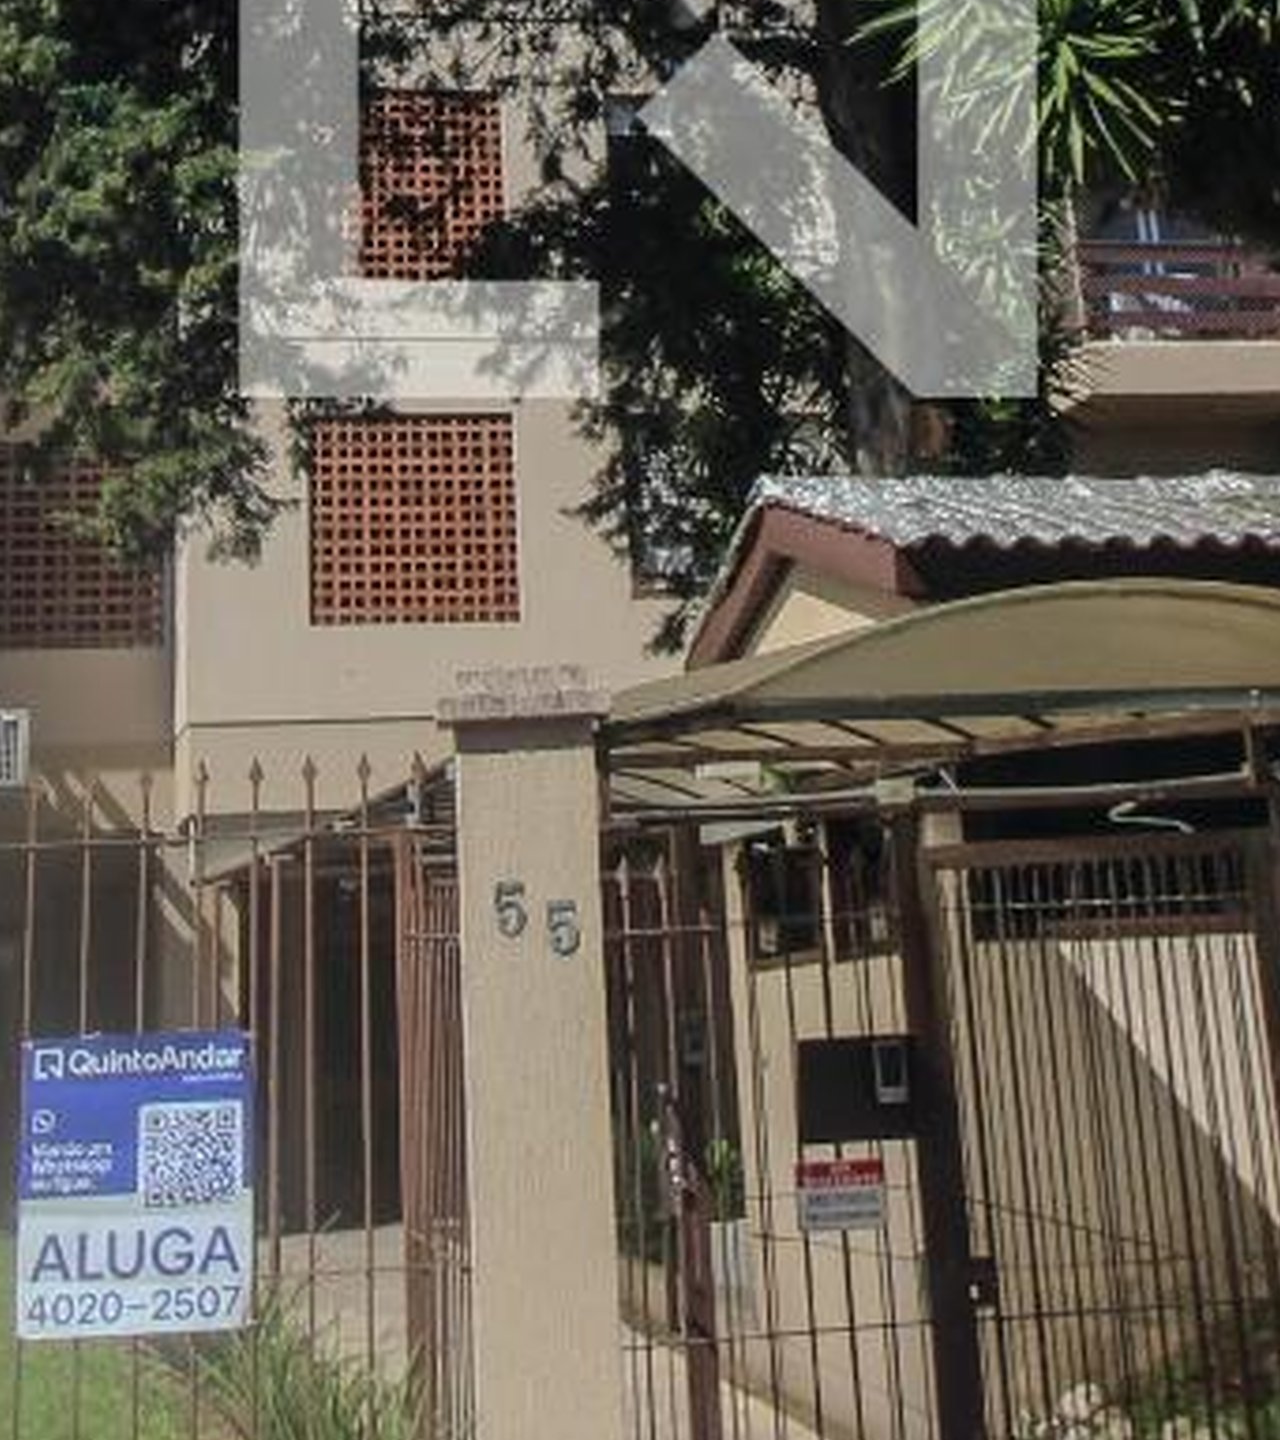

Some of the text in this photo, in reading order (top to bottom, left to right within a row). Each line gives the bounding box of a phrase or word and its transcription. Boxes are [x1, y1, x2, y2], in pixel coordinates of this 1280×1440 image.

[493, 879, 581, 957] 55
[68, 1043, 244, 1076] QuintoAndar
[30, 1226, 240, 1283] ALUGA
[27, 1285, 242, 1327] 4020-2507
